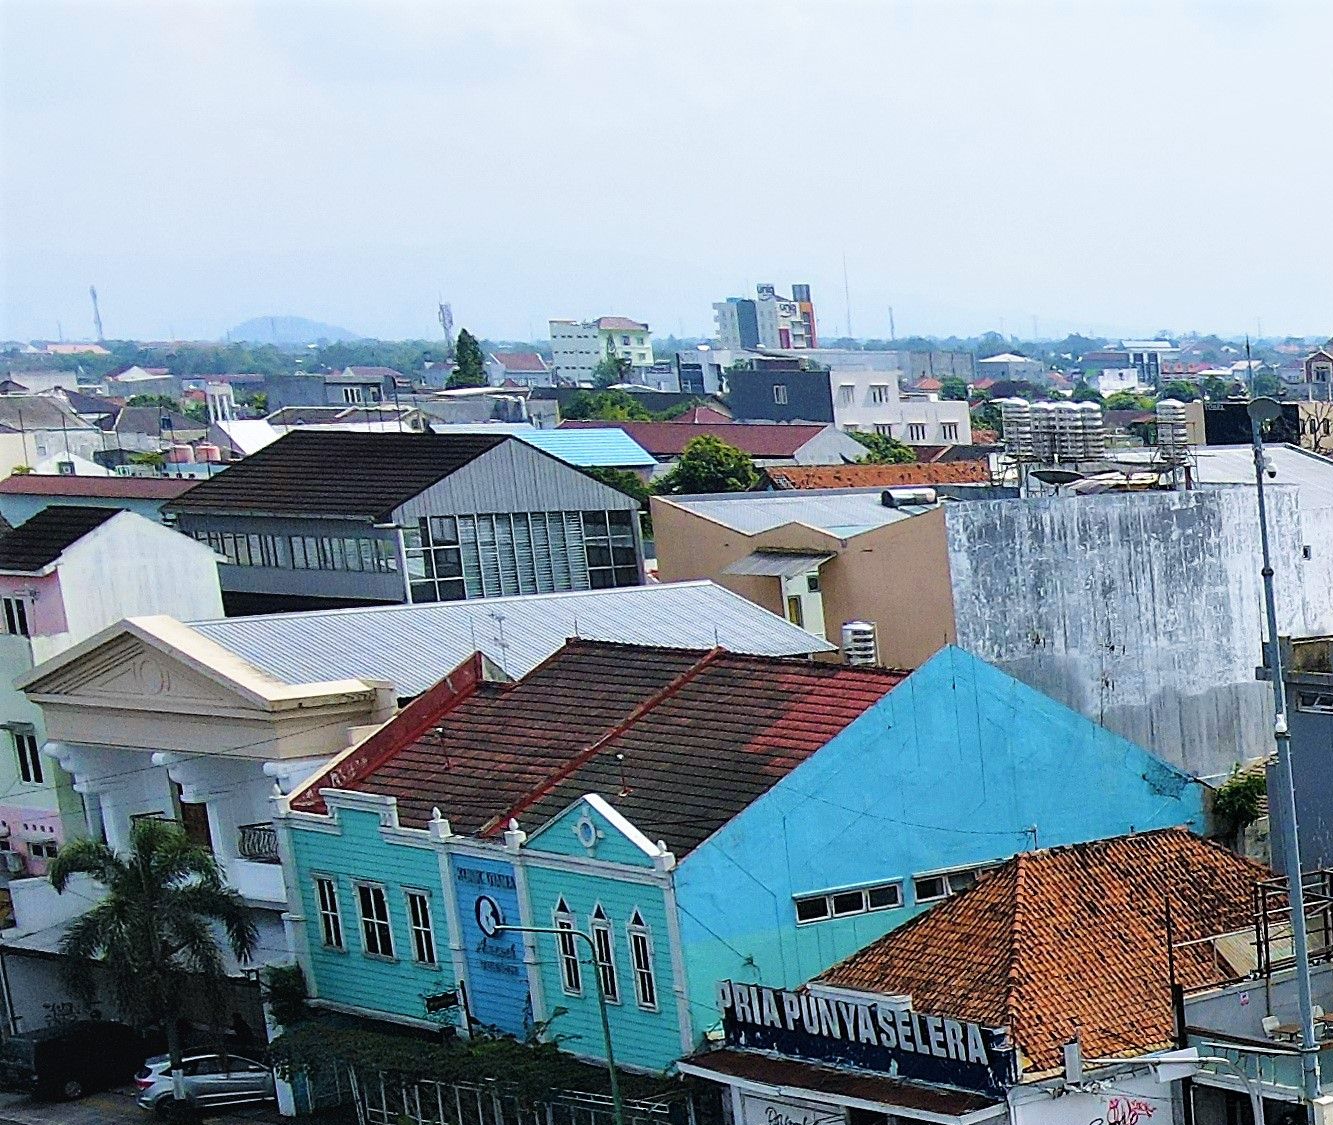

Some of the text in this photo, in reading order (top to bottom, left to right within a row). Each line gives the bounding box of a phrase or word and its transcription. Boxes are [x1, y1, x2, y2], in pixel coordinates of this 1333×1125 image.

[716, 980, 989, 1065] PRIA PUNYA SELERA
